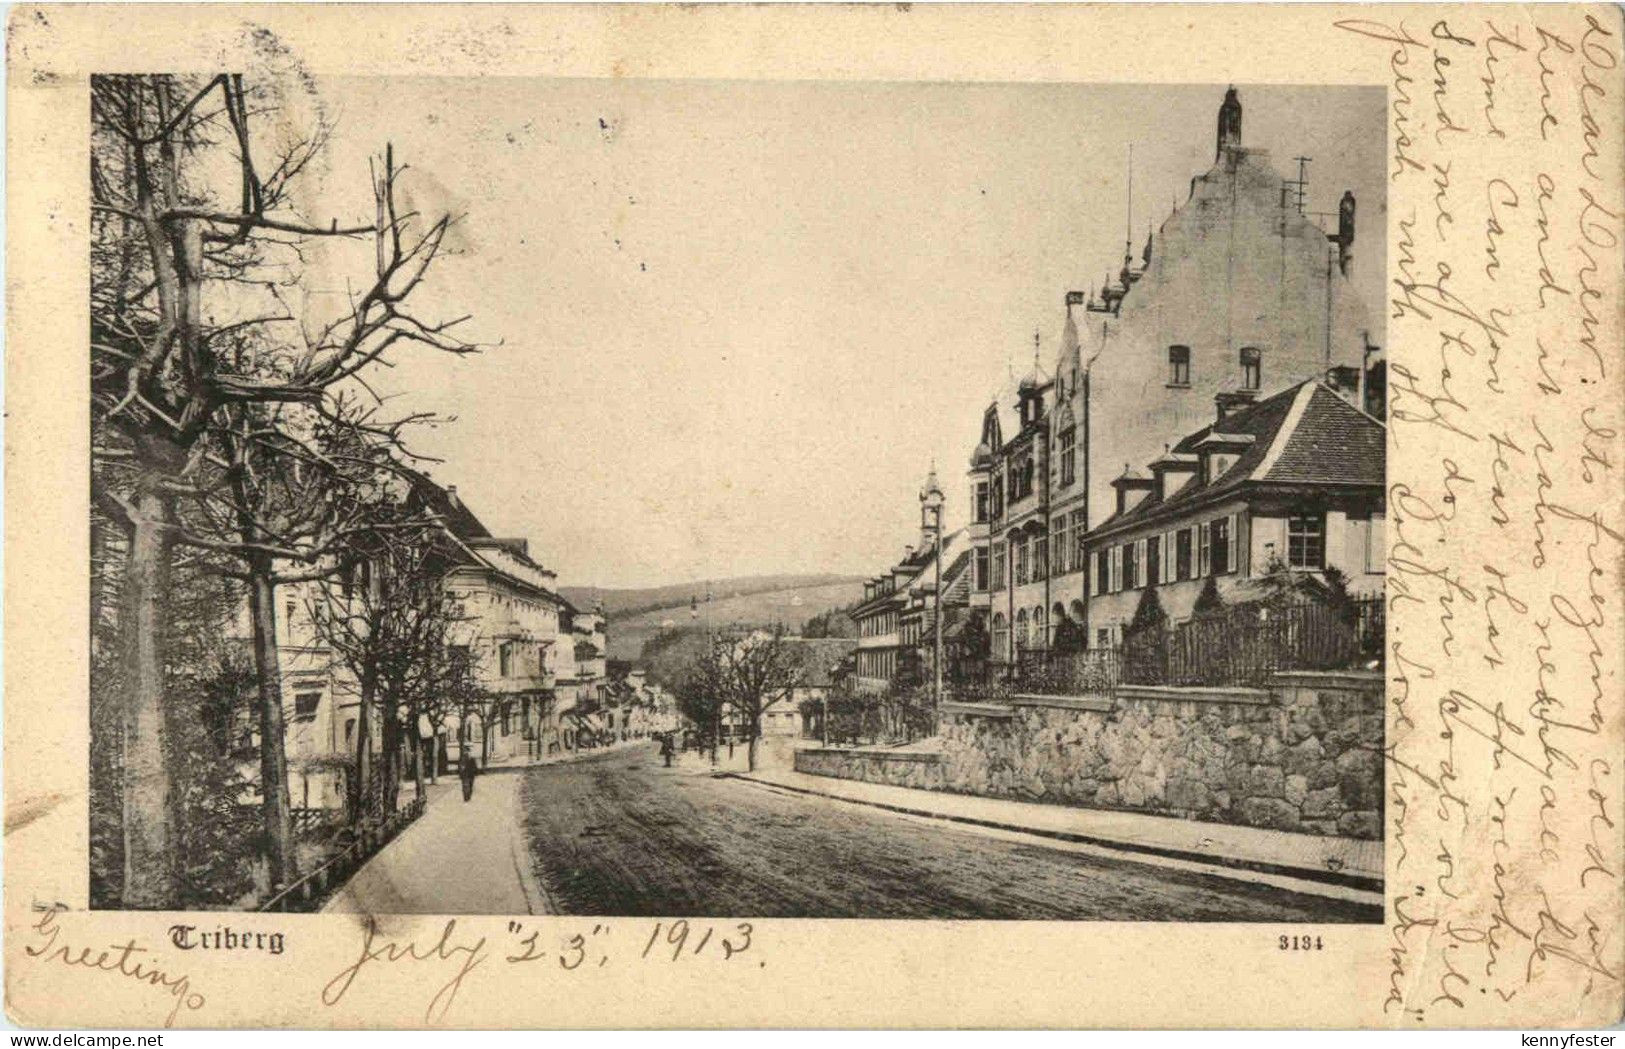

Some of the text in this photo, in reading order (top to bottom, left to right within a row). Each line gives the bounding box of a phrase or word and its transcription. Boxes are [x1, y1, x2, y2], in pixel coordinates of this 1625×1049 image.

[1332, 20, 1429, 181] perish
[1431, 21, 1475, 144] Send
[1481, 21, 1527, 140] time
[1534, 27, 1575, 140] here
[1579, 15, 1617, 178] Dear
[1432, 160, 1453, 240] me
[1536, 173, 1571, 308] and
[1391, 210, 1432, 320] with
[1389, 363, 1420, 449] the
[1482, 565, 1528, 668] that
[1392, 642, 1435, 729] Love
[1374, 742, 1439, 870] from
[1579, 759, 1615, 888] cold
[168, 924, 285, 954] Triberg
[321, 916, 489, 1025] July
